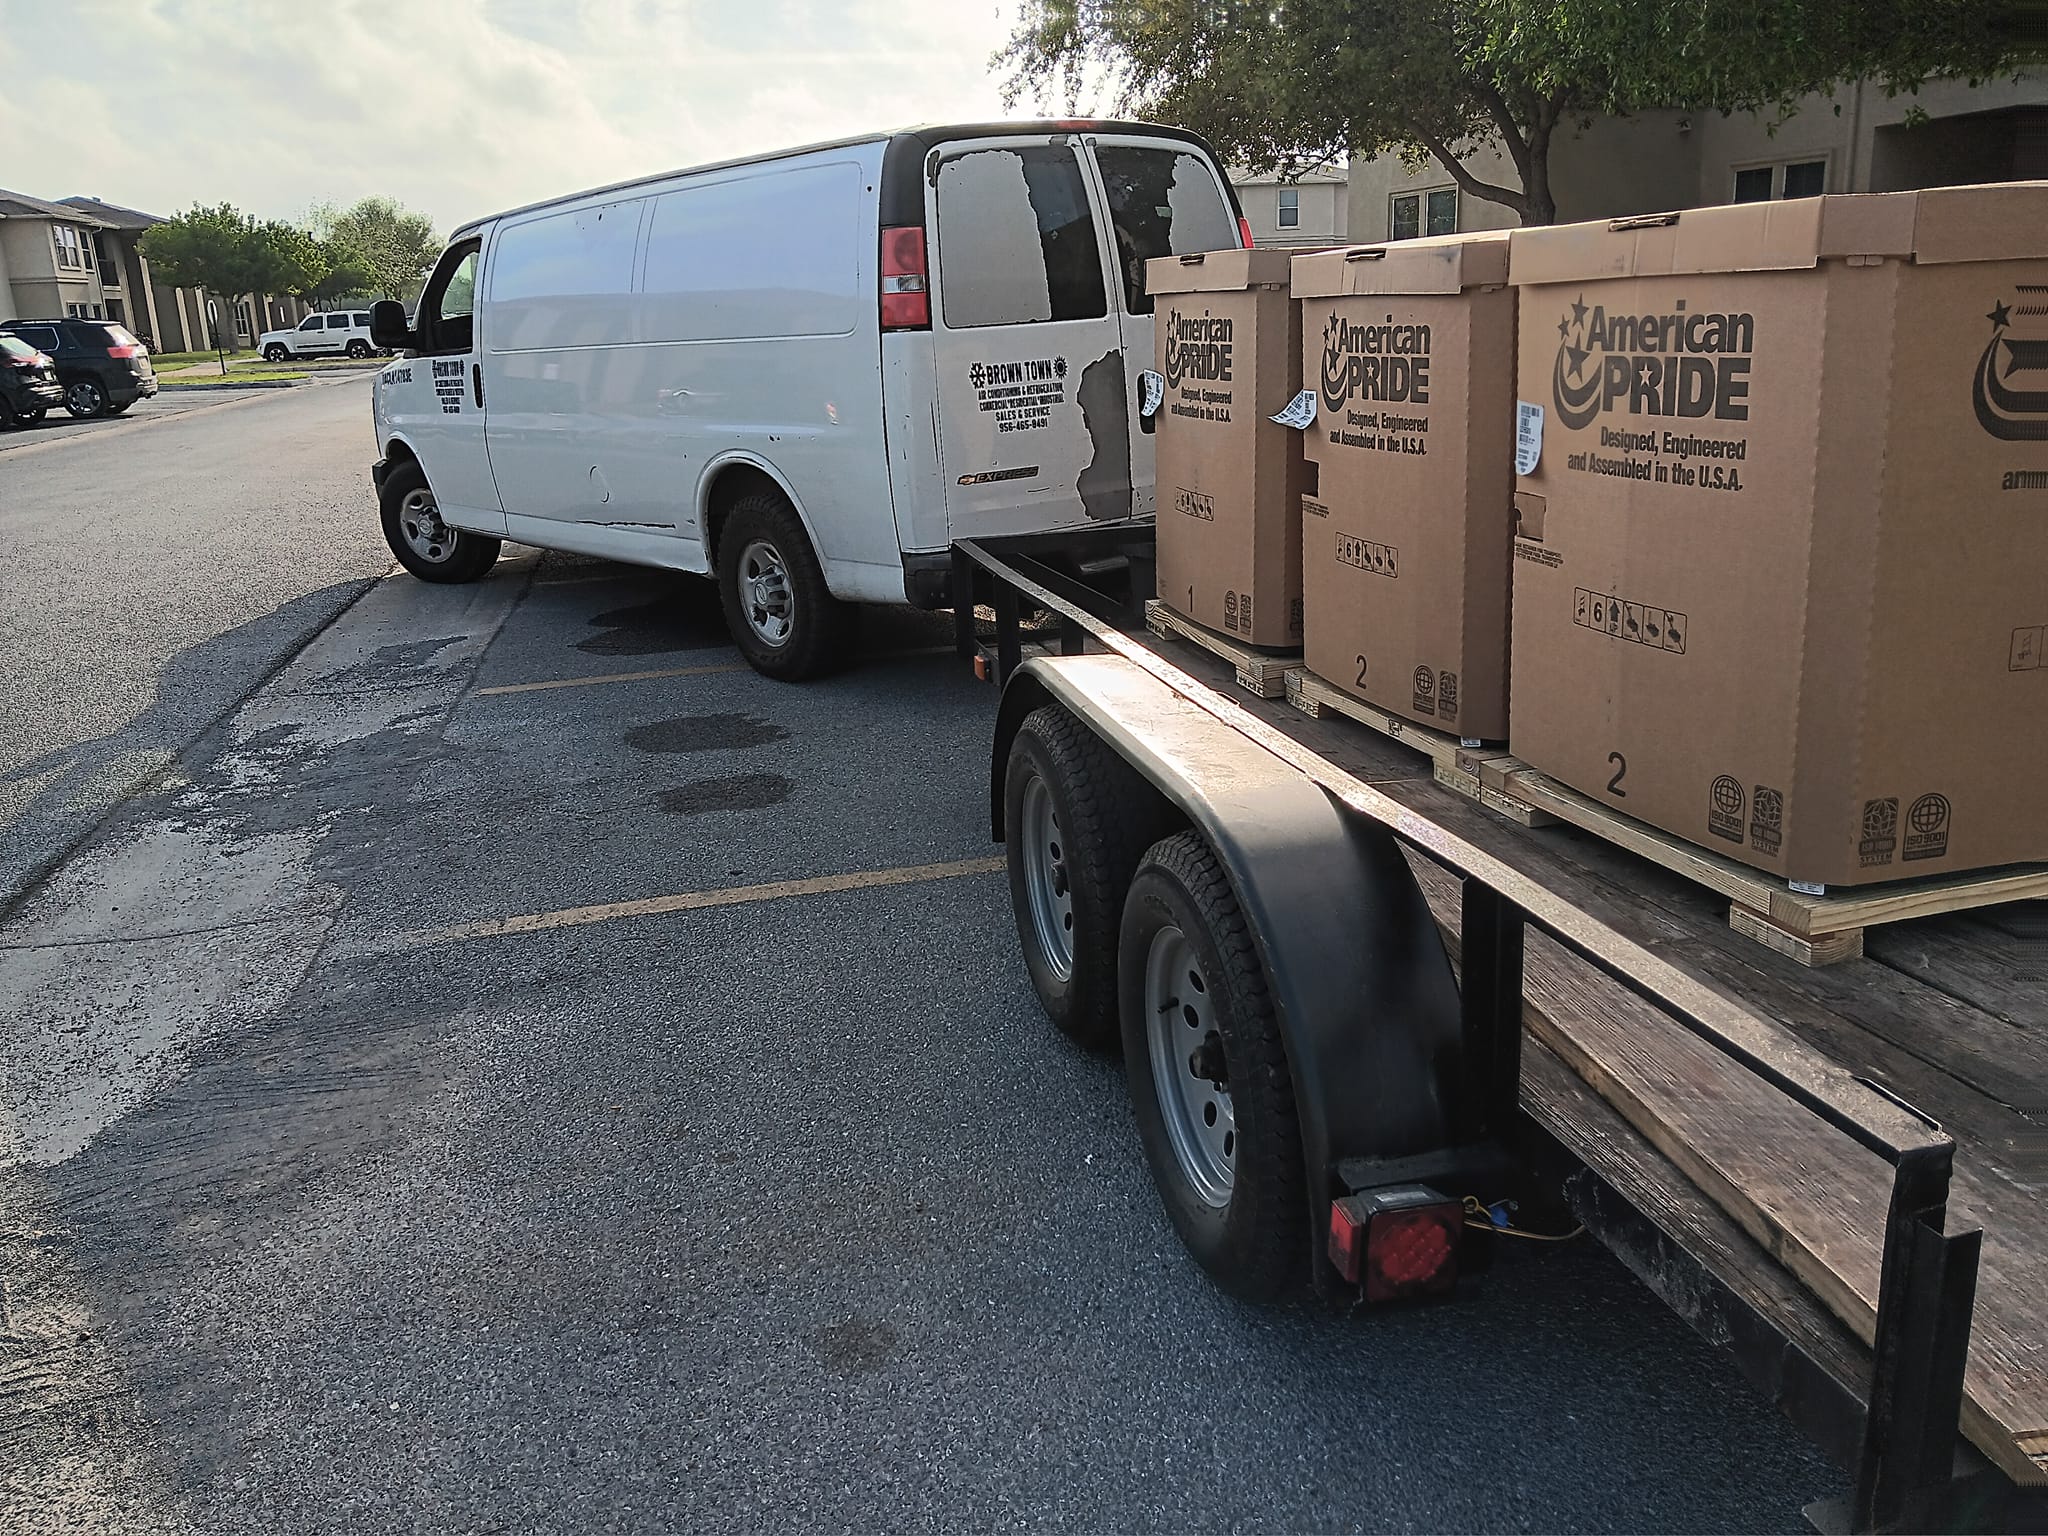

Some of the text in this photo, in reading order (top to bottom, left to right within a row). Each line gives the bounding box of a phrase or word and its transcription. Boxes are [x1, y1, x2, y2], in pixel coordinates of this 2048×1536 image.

[1176, 309, 1233, 343] American
[1338, 314, 1431, 355] American
[1587, 299, 1754, 353] American
[986, 359, 1052, 385] BROWN TOWN
[1180, 342, 1232, 382] PRIDE
[1346, 356, 1430, 404] PRIDE
[1602, 355, 1751, 421] PRIDE
[995, 409, 1016, 422] SALES
[1024, 406, 1051, 418] SERVICE
[1199, 407, 1204, 419] in
[1205, 408, 1214, 421] the
[1215, 409, 1232, 423] U.S.A.
[1346, 409, 1429, 434] Designed, Engineered
[1329, 429, 1428, 456] and Assembled in the U.S.A.
[1601, 425, 1747, 460] Designed, Engineered
[976, 467, 1038, 483] EXPRESS
[1568, 452, 1744, 492] and Assembled in the U.S.A.
[1346, 542, 1352, 559] 6
[1187, 585, 1193, 613] 1
[1594, 601, 1603, 623] 6
[1355, 654, 1368, 690] 2
[1607, 751, 1627, 798] 2
[1711, 809, 1724, 823] ISO
[1725, 813, 1742, 828] 9001
[1906, 831, 1946, 845] ISO 9001
